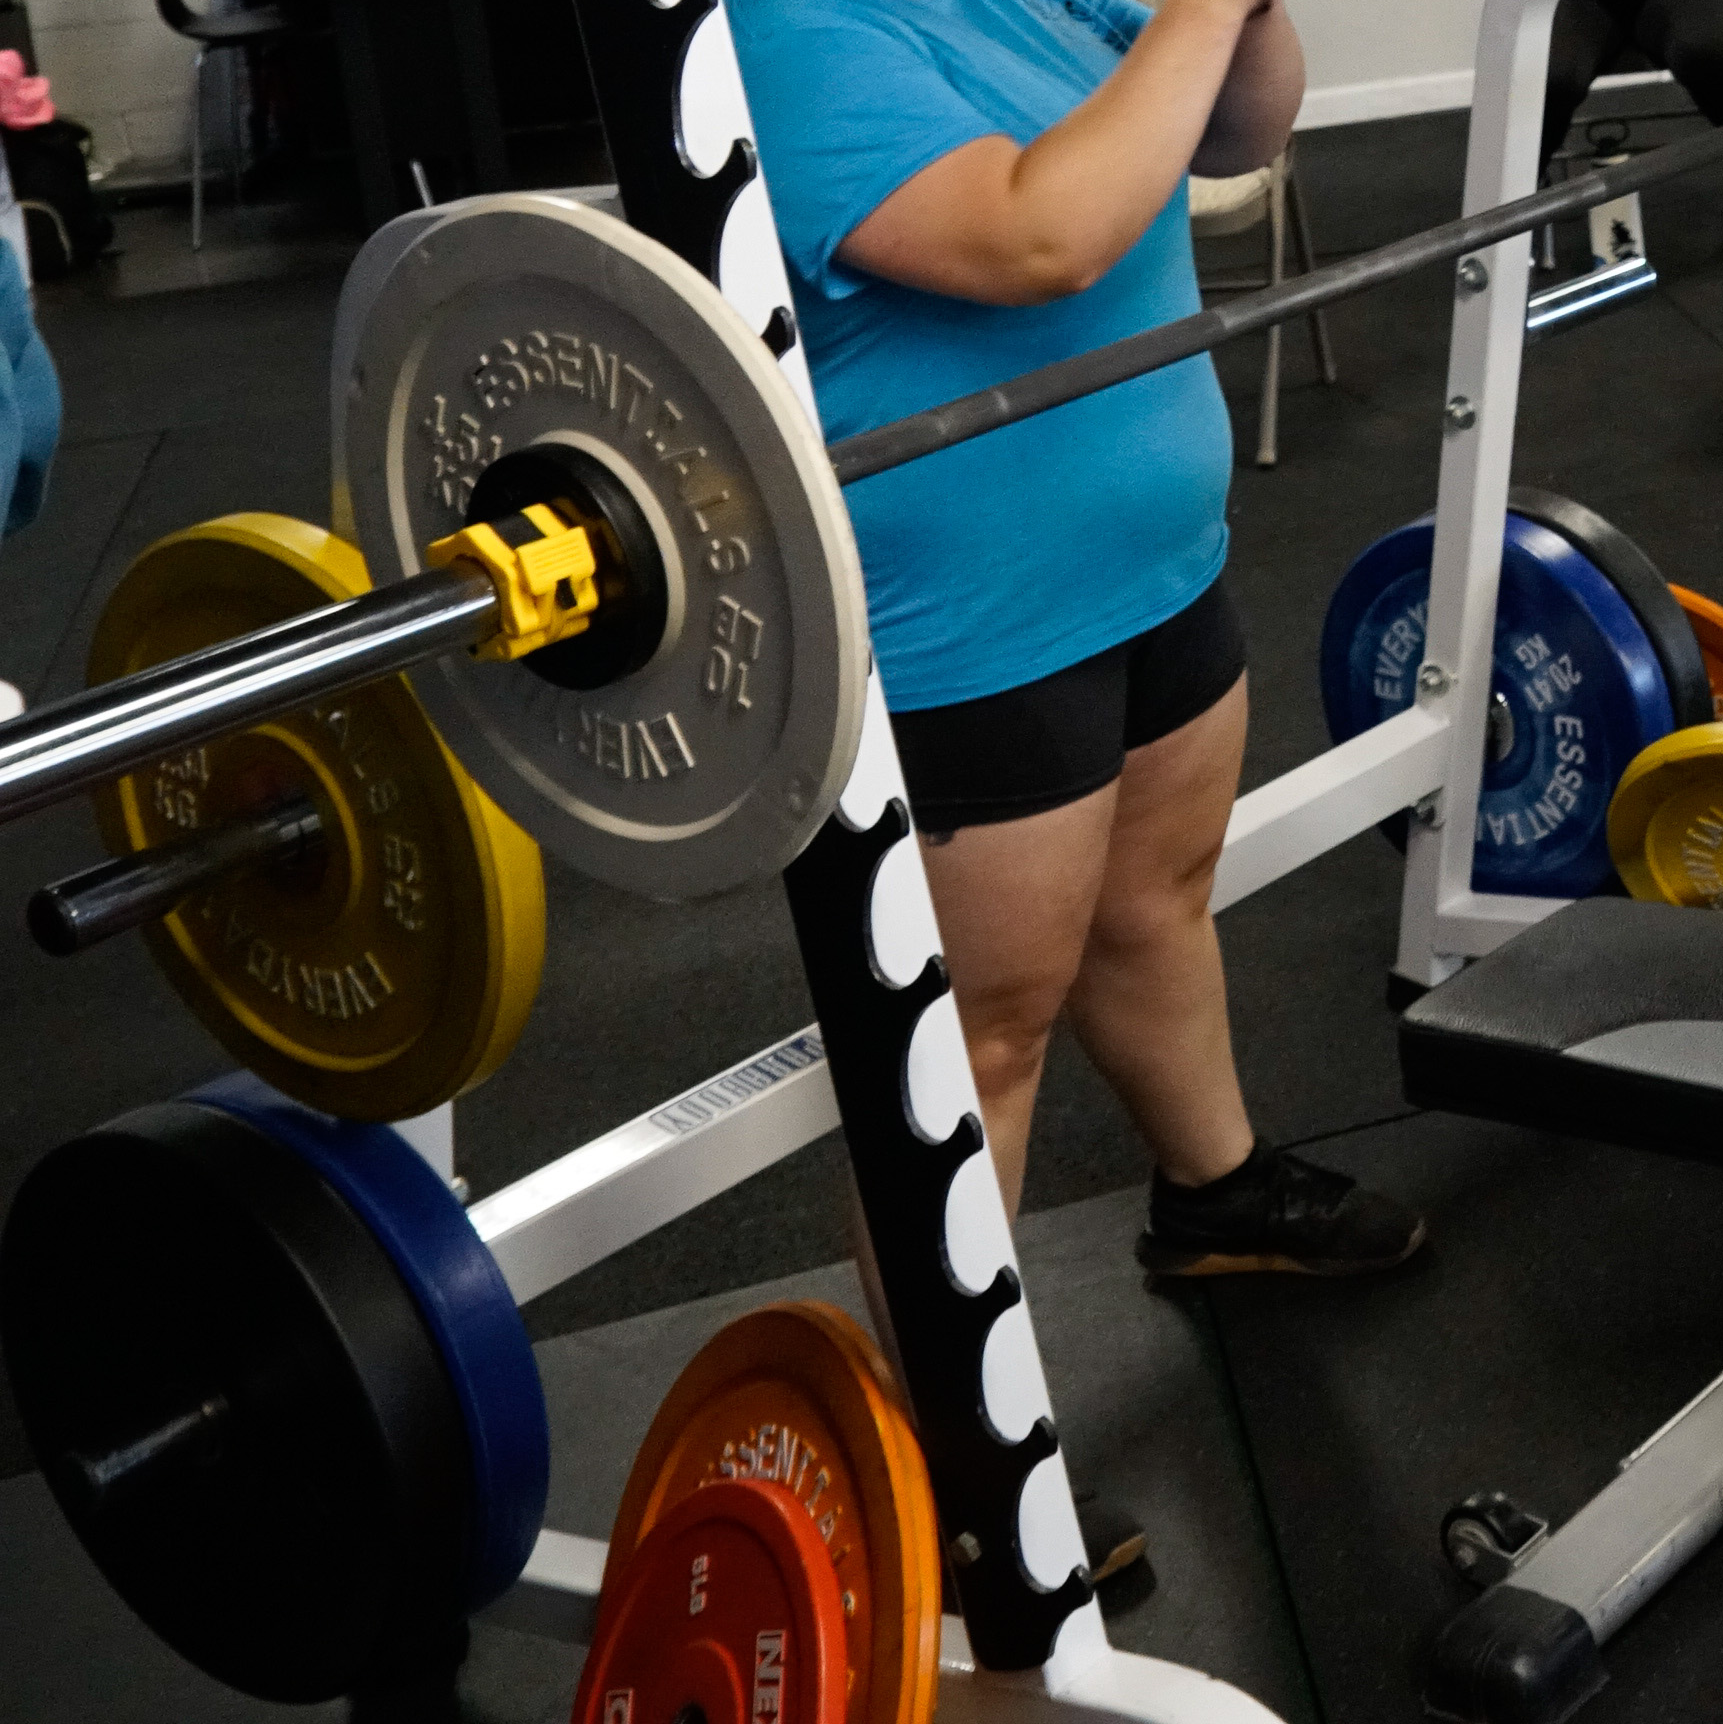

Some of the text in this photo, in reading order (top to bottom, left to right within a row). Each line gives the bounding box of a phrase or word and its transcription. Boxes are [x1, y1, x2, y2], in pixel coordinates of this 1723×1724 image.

[474, 329, 752, 574] ESSENTIALS
[1515, 633, 1552, 670] KG
[1524, 653, 1582, 713] 20.41
[1475, 714, 1585, 846] ESSENTIAL
